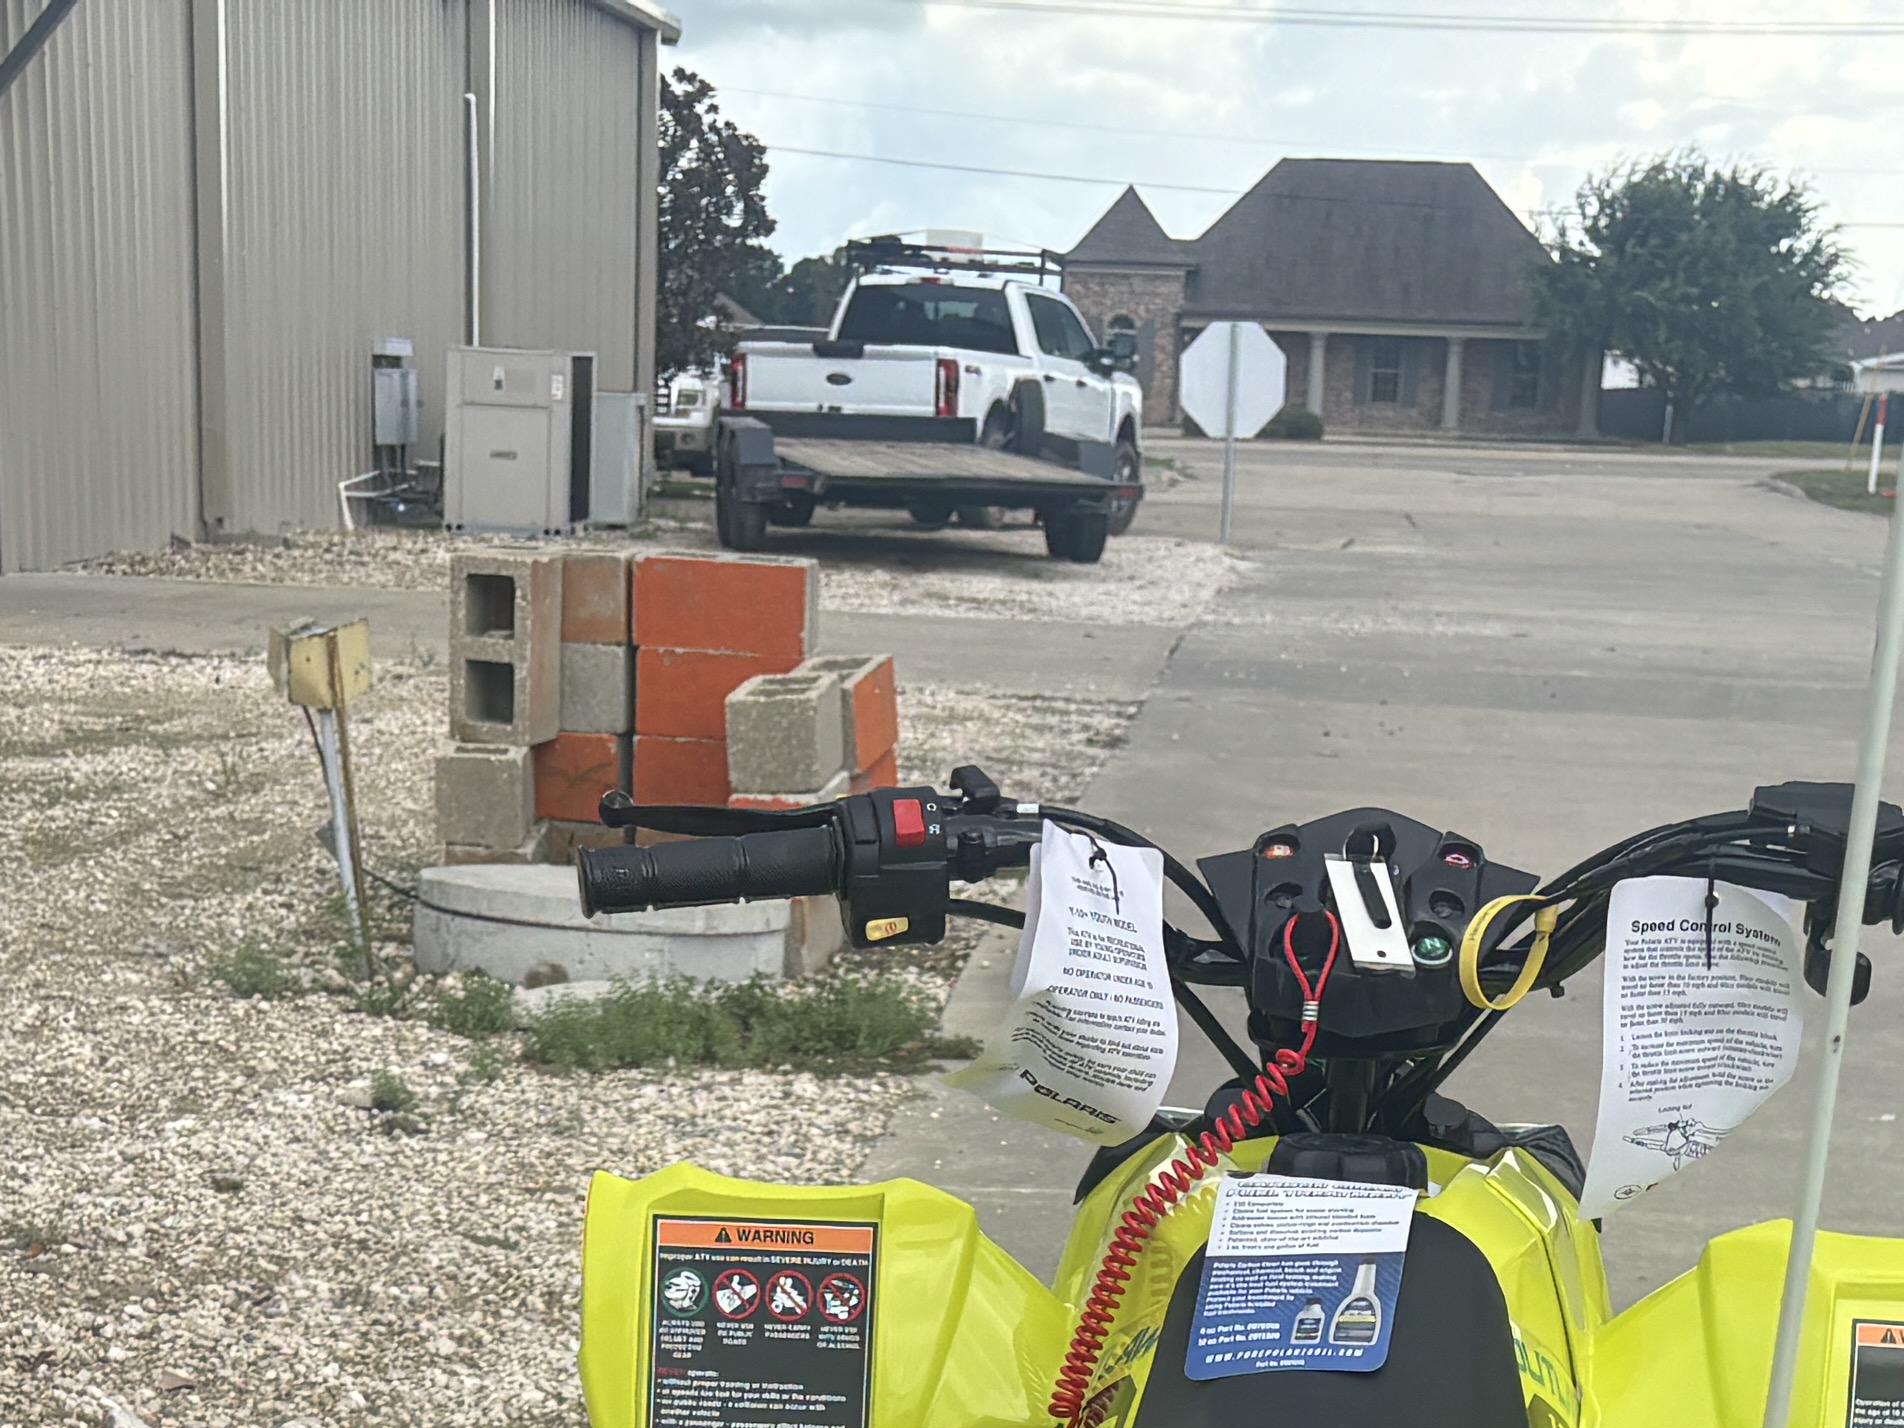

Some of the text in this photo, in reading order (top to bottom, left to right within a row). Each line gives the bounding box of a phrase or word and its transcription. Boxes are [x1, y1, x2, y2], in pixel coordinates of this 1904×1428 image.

[1631, 919, 1781, 947] Speed Conrol System
[1020, 1069, 1122, 1124] POLARIS
[737, 1229, 814, 1244] WARNING
